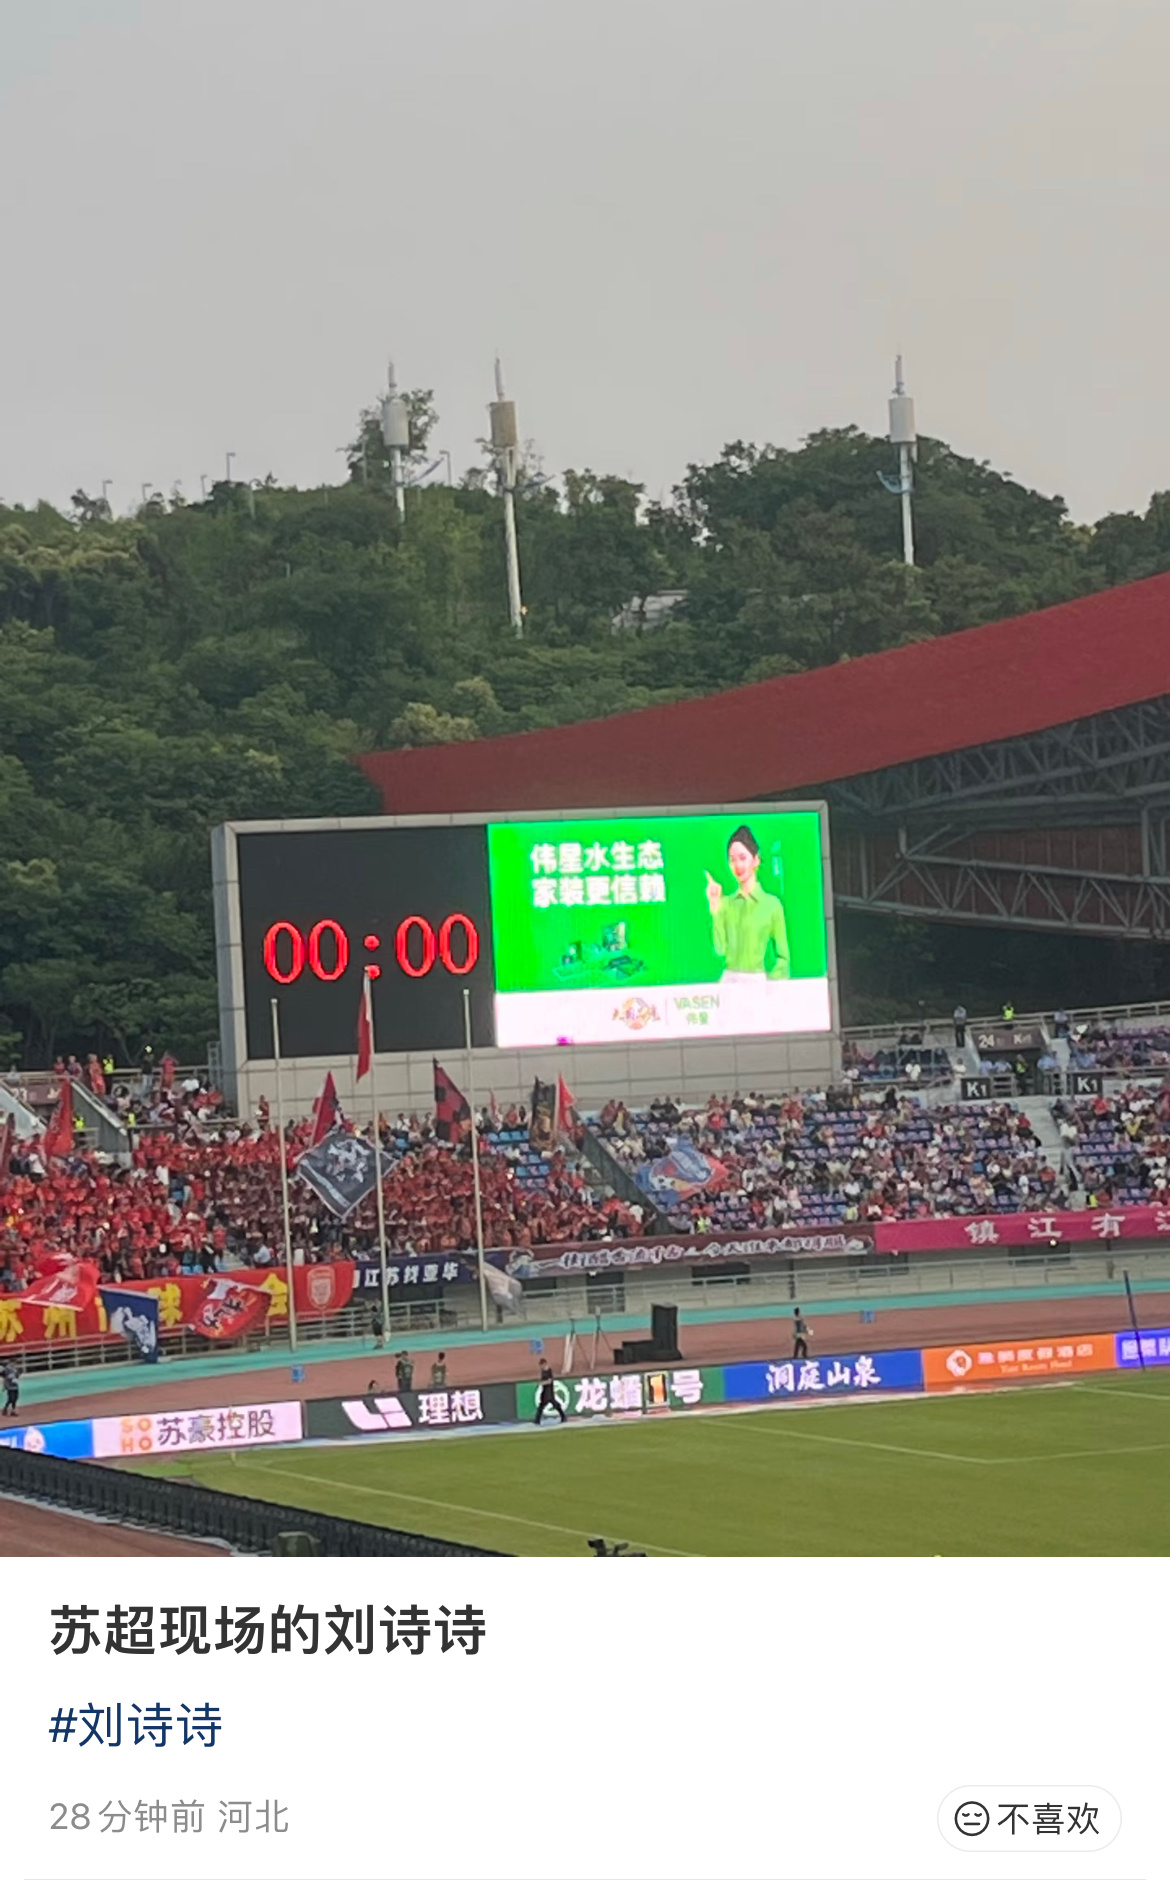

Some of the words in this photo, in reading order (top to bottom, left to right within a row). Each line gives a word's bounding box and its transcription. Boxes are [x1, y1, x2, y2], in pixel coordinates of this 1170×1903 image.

[530, 839, 664, 874] 伟星水生态
[531, 873, 666, 907] 家装更信赖
[263, 913, 479, 984] 00:00
[674, 995, 720, 1010] VASEN
[966, 1078, 987, 1098] K1
[1077, 1076, 1098, 1093] K1
[766, 1356, 881, 1394] 洞庭山泉
[418, 1390, 483, 1426] 理想
[156, 1409, 276, 1446] 苏豪控股
